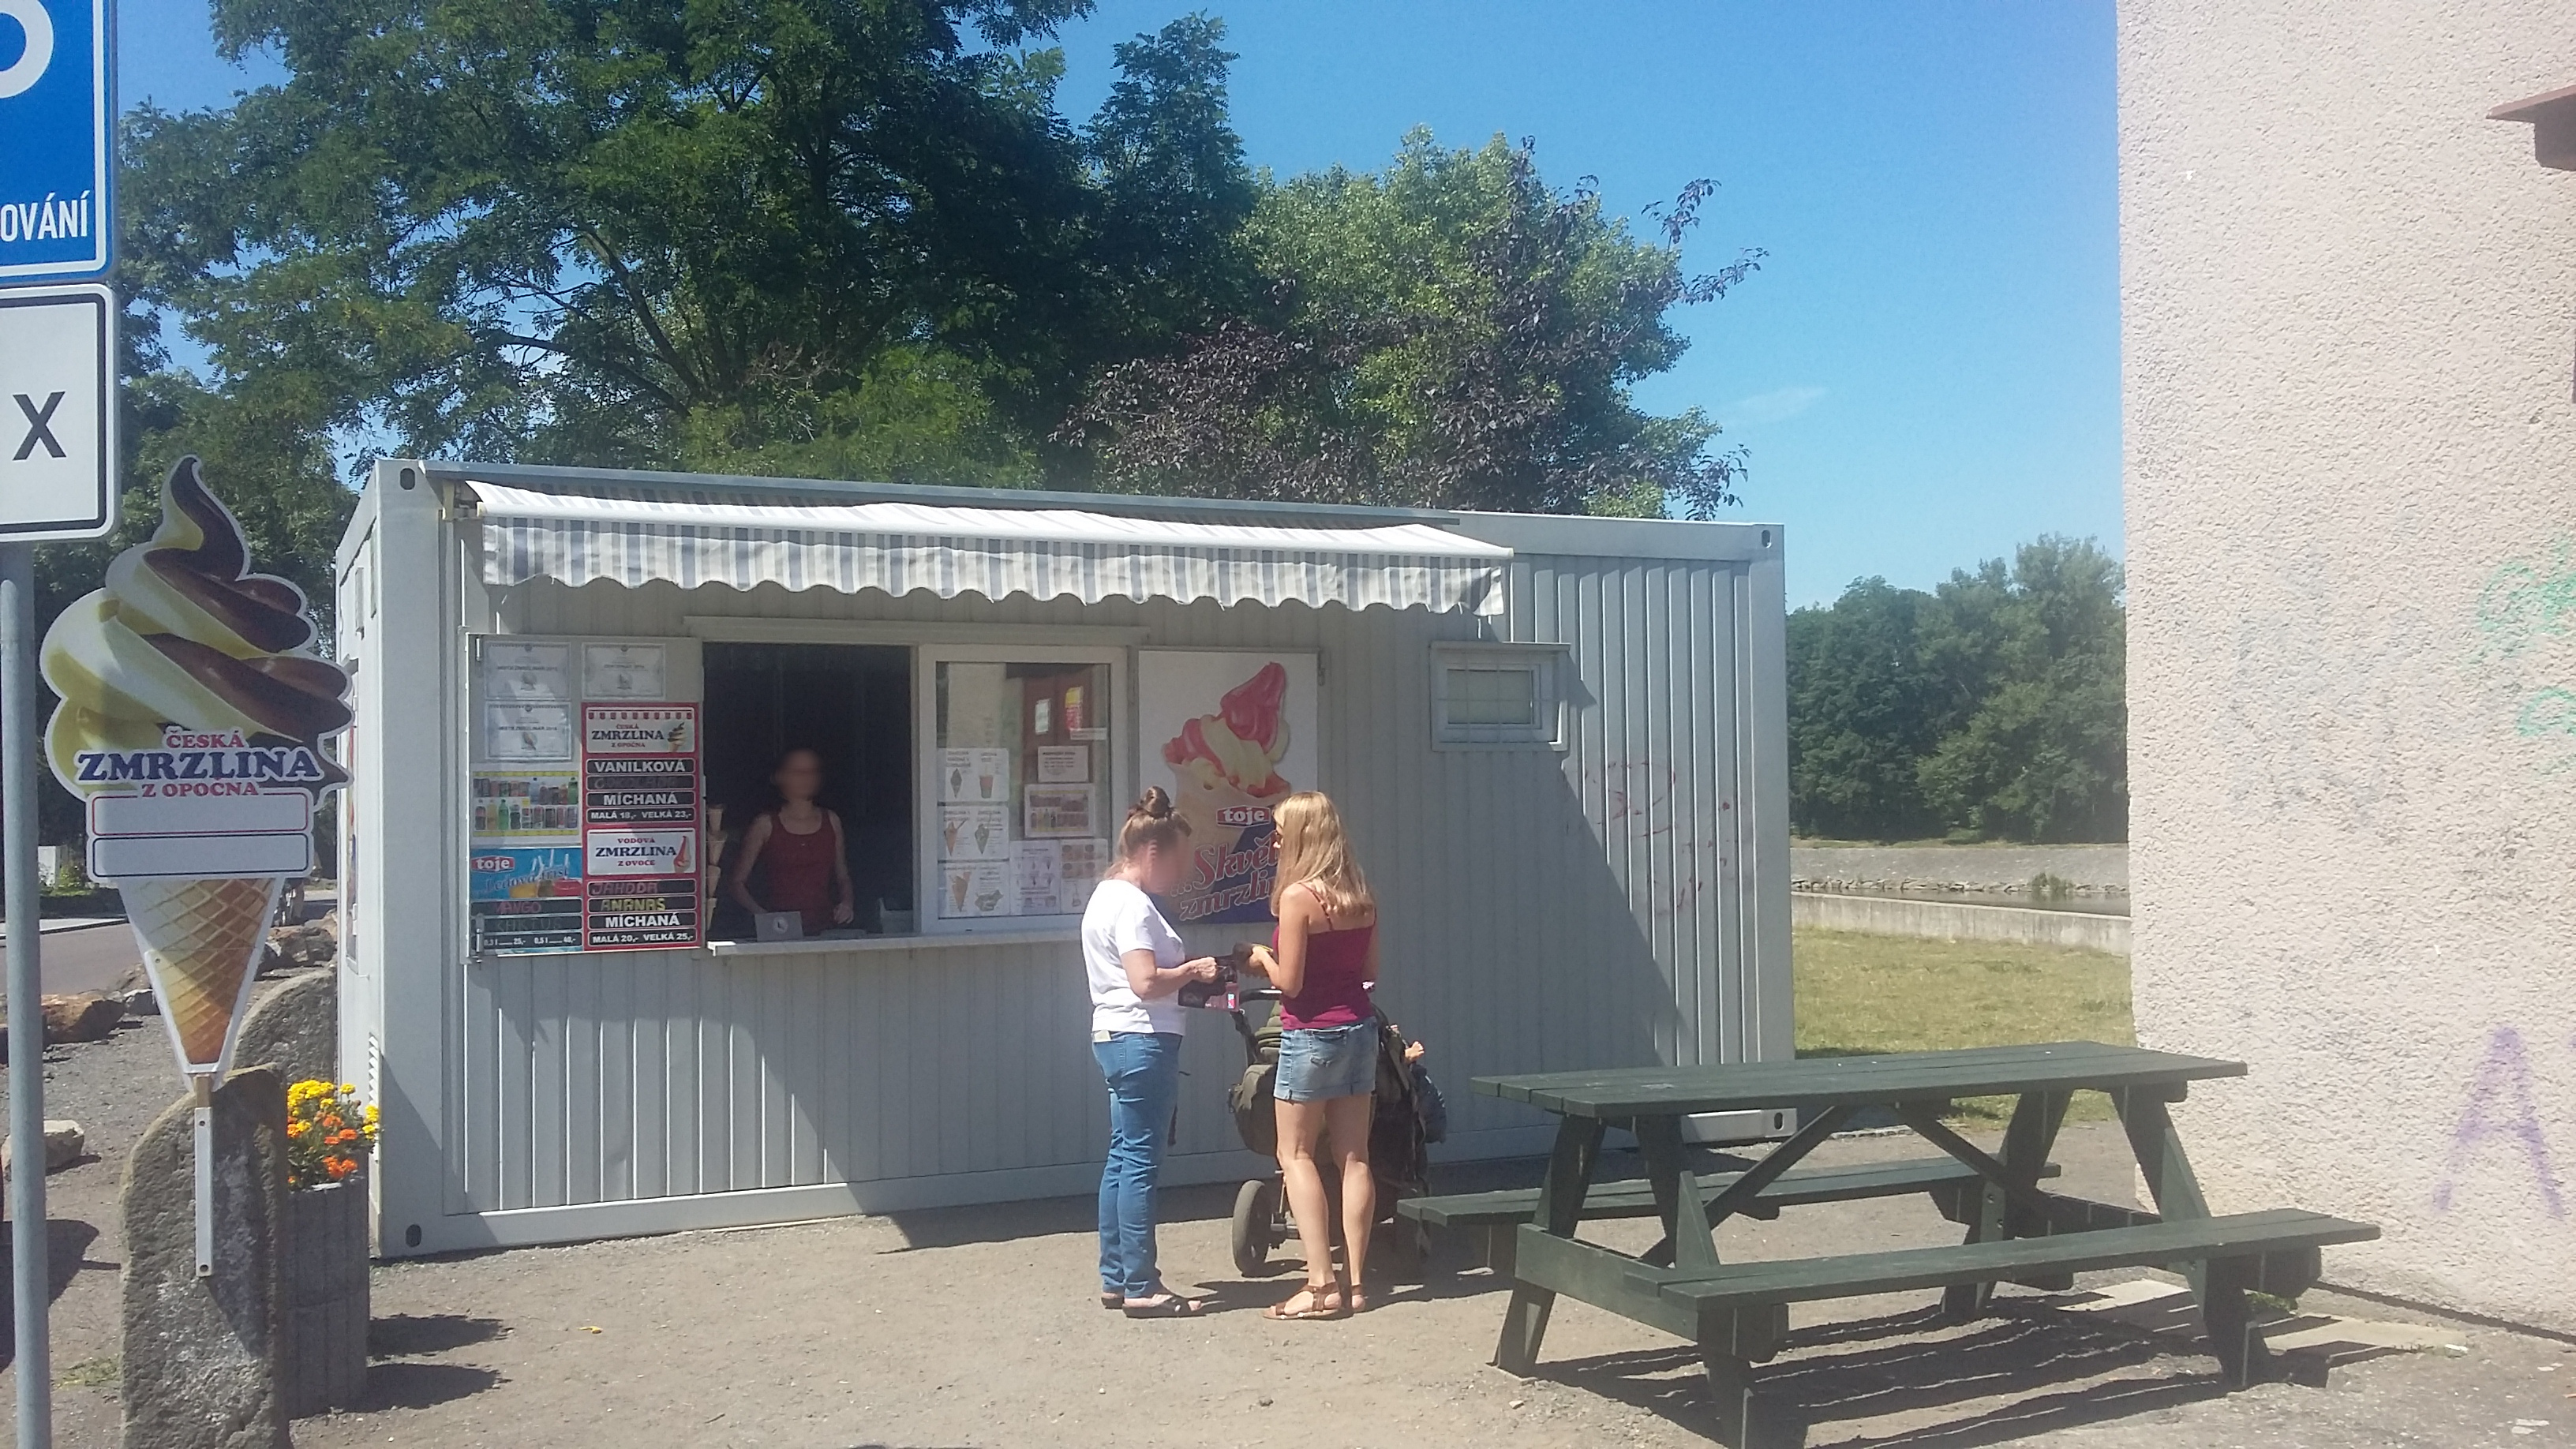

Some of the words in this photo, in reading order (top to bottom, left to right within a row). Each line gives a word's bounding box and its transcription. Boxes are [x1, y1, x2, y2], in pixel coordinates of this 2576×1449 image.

[12, 391, 66, 461] X
[166, 730, 244, 749] ČESKÁ
[591, 730, 665, 740] ZMRZLINA
[78, 751, 320, 781] ZMRZLINA
[594, 759, 686, 773] VANILKOVÁ
[141, 784, 157, 797] Z
[161, 778, 259, 797] OPOČNA
[604, 792, 678, 805] MÍCHANÁ
[642, 809, 673, 818] VELKÁ
[1223, 807, 1265, 826] toje
[595, 846, 677, 857] ZMRZLINA
[476, 856, 511, 872] toje
[601, 897, 666, 912] ANANAS
[605, 912, 680, 927] MÍCHANÁ
[593, 934, 619, 943] MALÁ
[643, 932, 674, 941] VELKÁ
